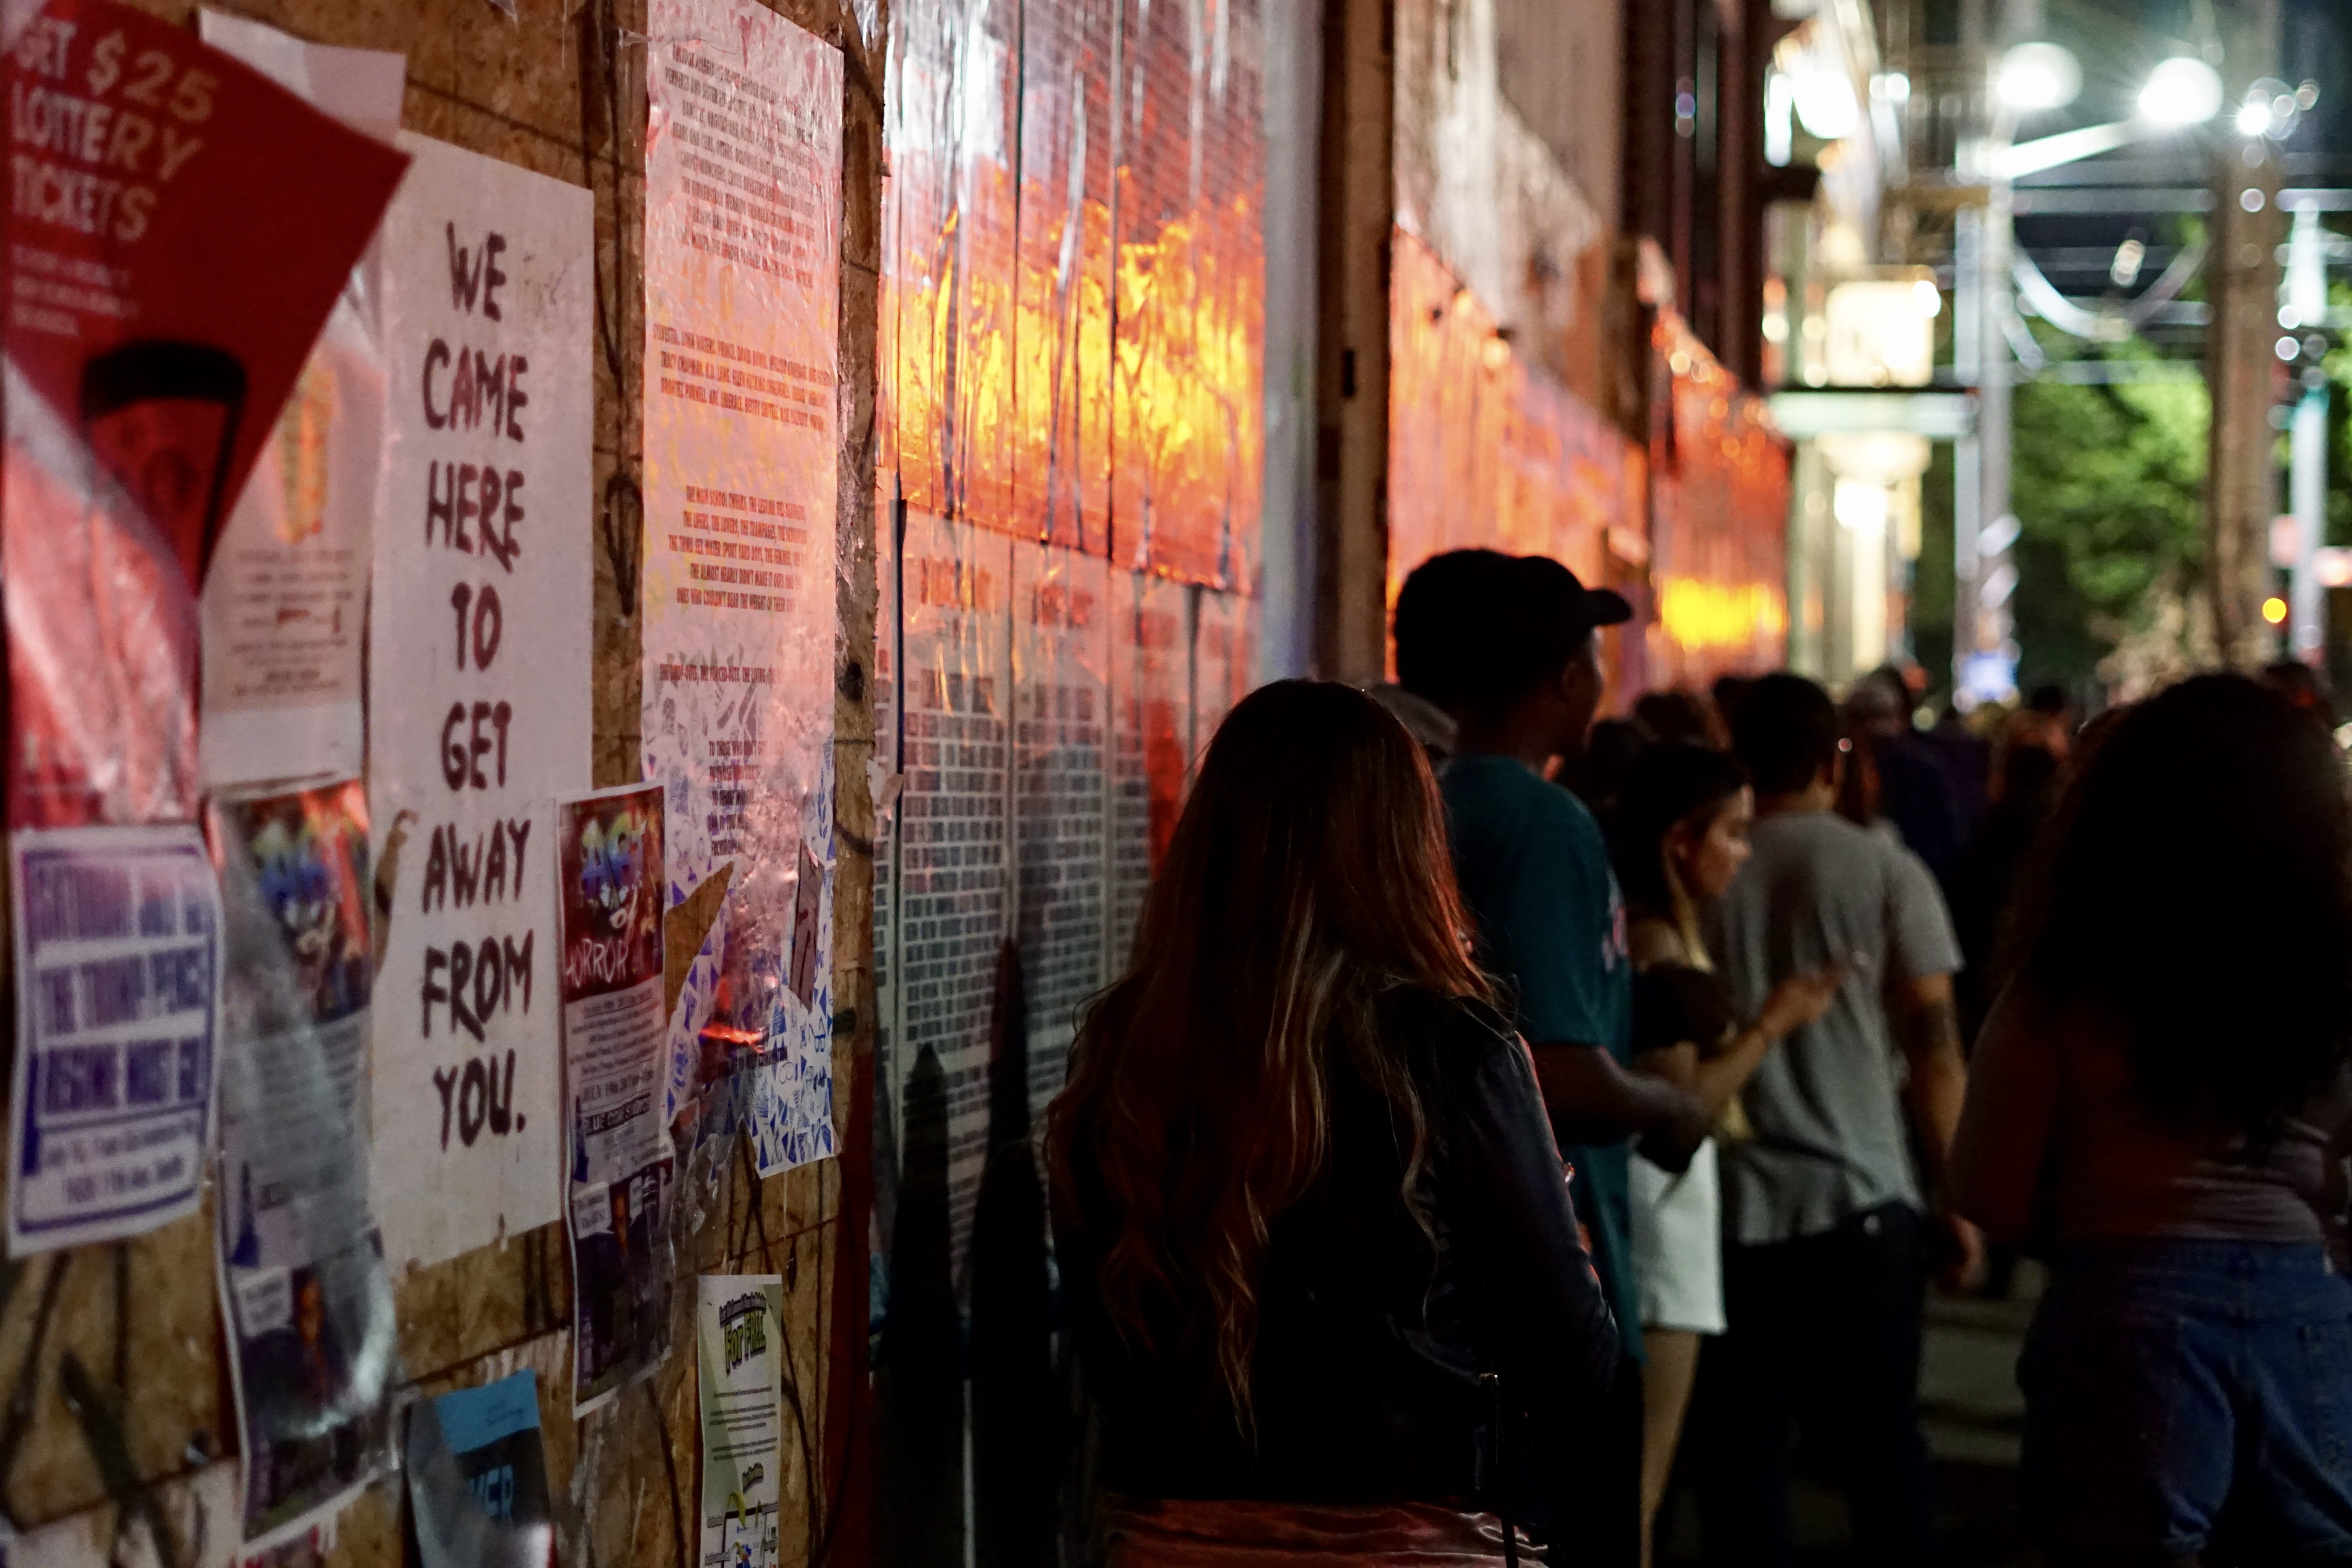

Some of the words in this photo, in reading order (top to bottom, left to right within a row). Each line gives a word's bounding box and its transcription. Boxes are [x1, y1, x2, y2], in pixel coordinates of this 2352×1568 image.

[87, 29, 219, 123] $25
[12, 80, 205, 181] LOTTERY
[10, 155, 157, 242] TICKETS
[446, 221, 506, 322] WE
[423, 338, 529, 443] CAME
[661, 351, 676, 368] TRACY
[426, 460, 526, 573] HERE
[684, 511, 692, 527] THE
[711, 515, 720, 531] THE
[686, 485, 695, 503] THE
[669, 534, 678, 552] THE
[691, 563, 699, 579] THE
[701, 564, 719, 581] ALMOST
[769, 572, 773, 587] IT
[451, 582, 503, 671] TO
[677, 587, 689, 604] ONES
[690, 588, 701, 605] WHO
[704, 590, 726, 607] COULDN'T
[750, 594, 766, 611] WEIGHT
[767, 596, 772, 611] OF
[441, 701, 513, 792] GET
[709, 741, 715, 757] TO
[717, 741, 731, 757] THOSE
[732, 740, 742, 756] WHO
[710, 766, 715, 782] TO
[717, 765, 732, 781] THOSE
[712, 790, 718, 806] TO
[422, 817, 532, 914] AWAY
[421, 929, 534, 1043] FROM
[565, 937, 628, 988] HORROR
[433, 1049, 526, 1152] YOU.
